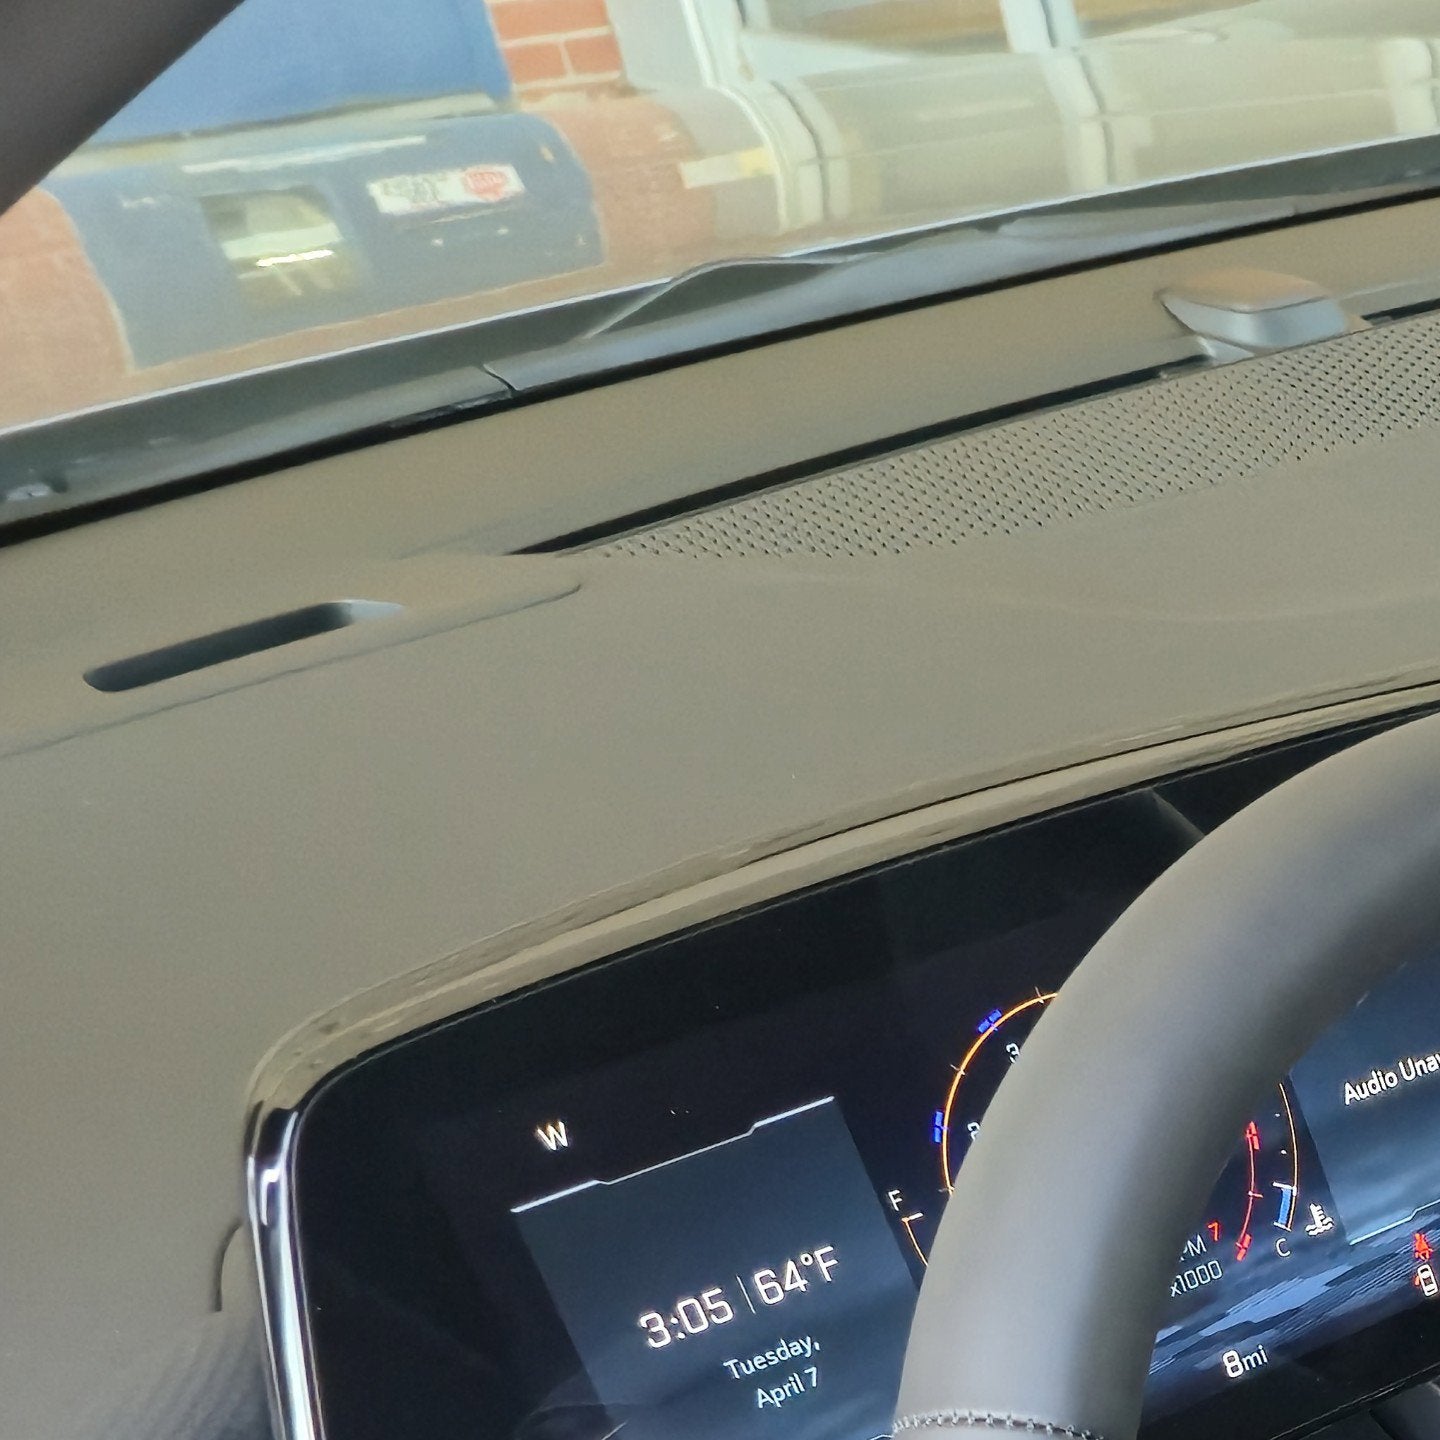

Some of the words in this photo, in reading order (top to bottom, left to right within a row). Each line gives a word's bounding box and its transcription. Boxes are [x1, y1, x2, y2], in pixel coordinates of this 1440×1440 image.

[1342, 1066, 1399, 1106] Audio
[536, 1120, 569, 1151] W
[887, 1189, 902, 1211] F
[1208, 1221, 1219, 1242] 7
[1276, 1238, 1290, 1257] C
[1170, 1260, 1223, 1297] x1000
[638, 1286, 735, 1350] 3:05
[751, 1245, 840, 1308] 64°F
[724, 1338, 821, 1382] Tuesday,
[1222, 1344, 1268, 1378] 8mi
[755, 1374, 806, 1410] April
[804, 1368, 820, 1390] 7
